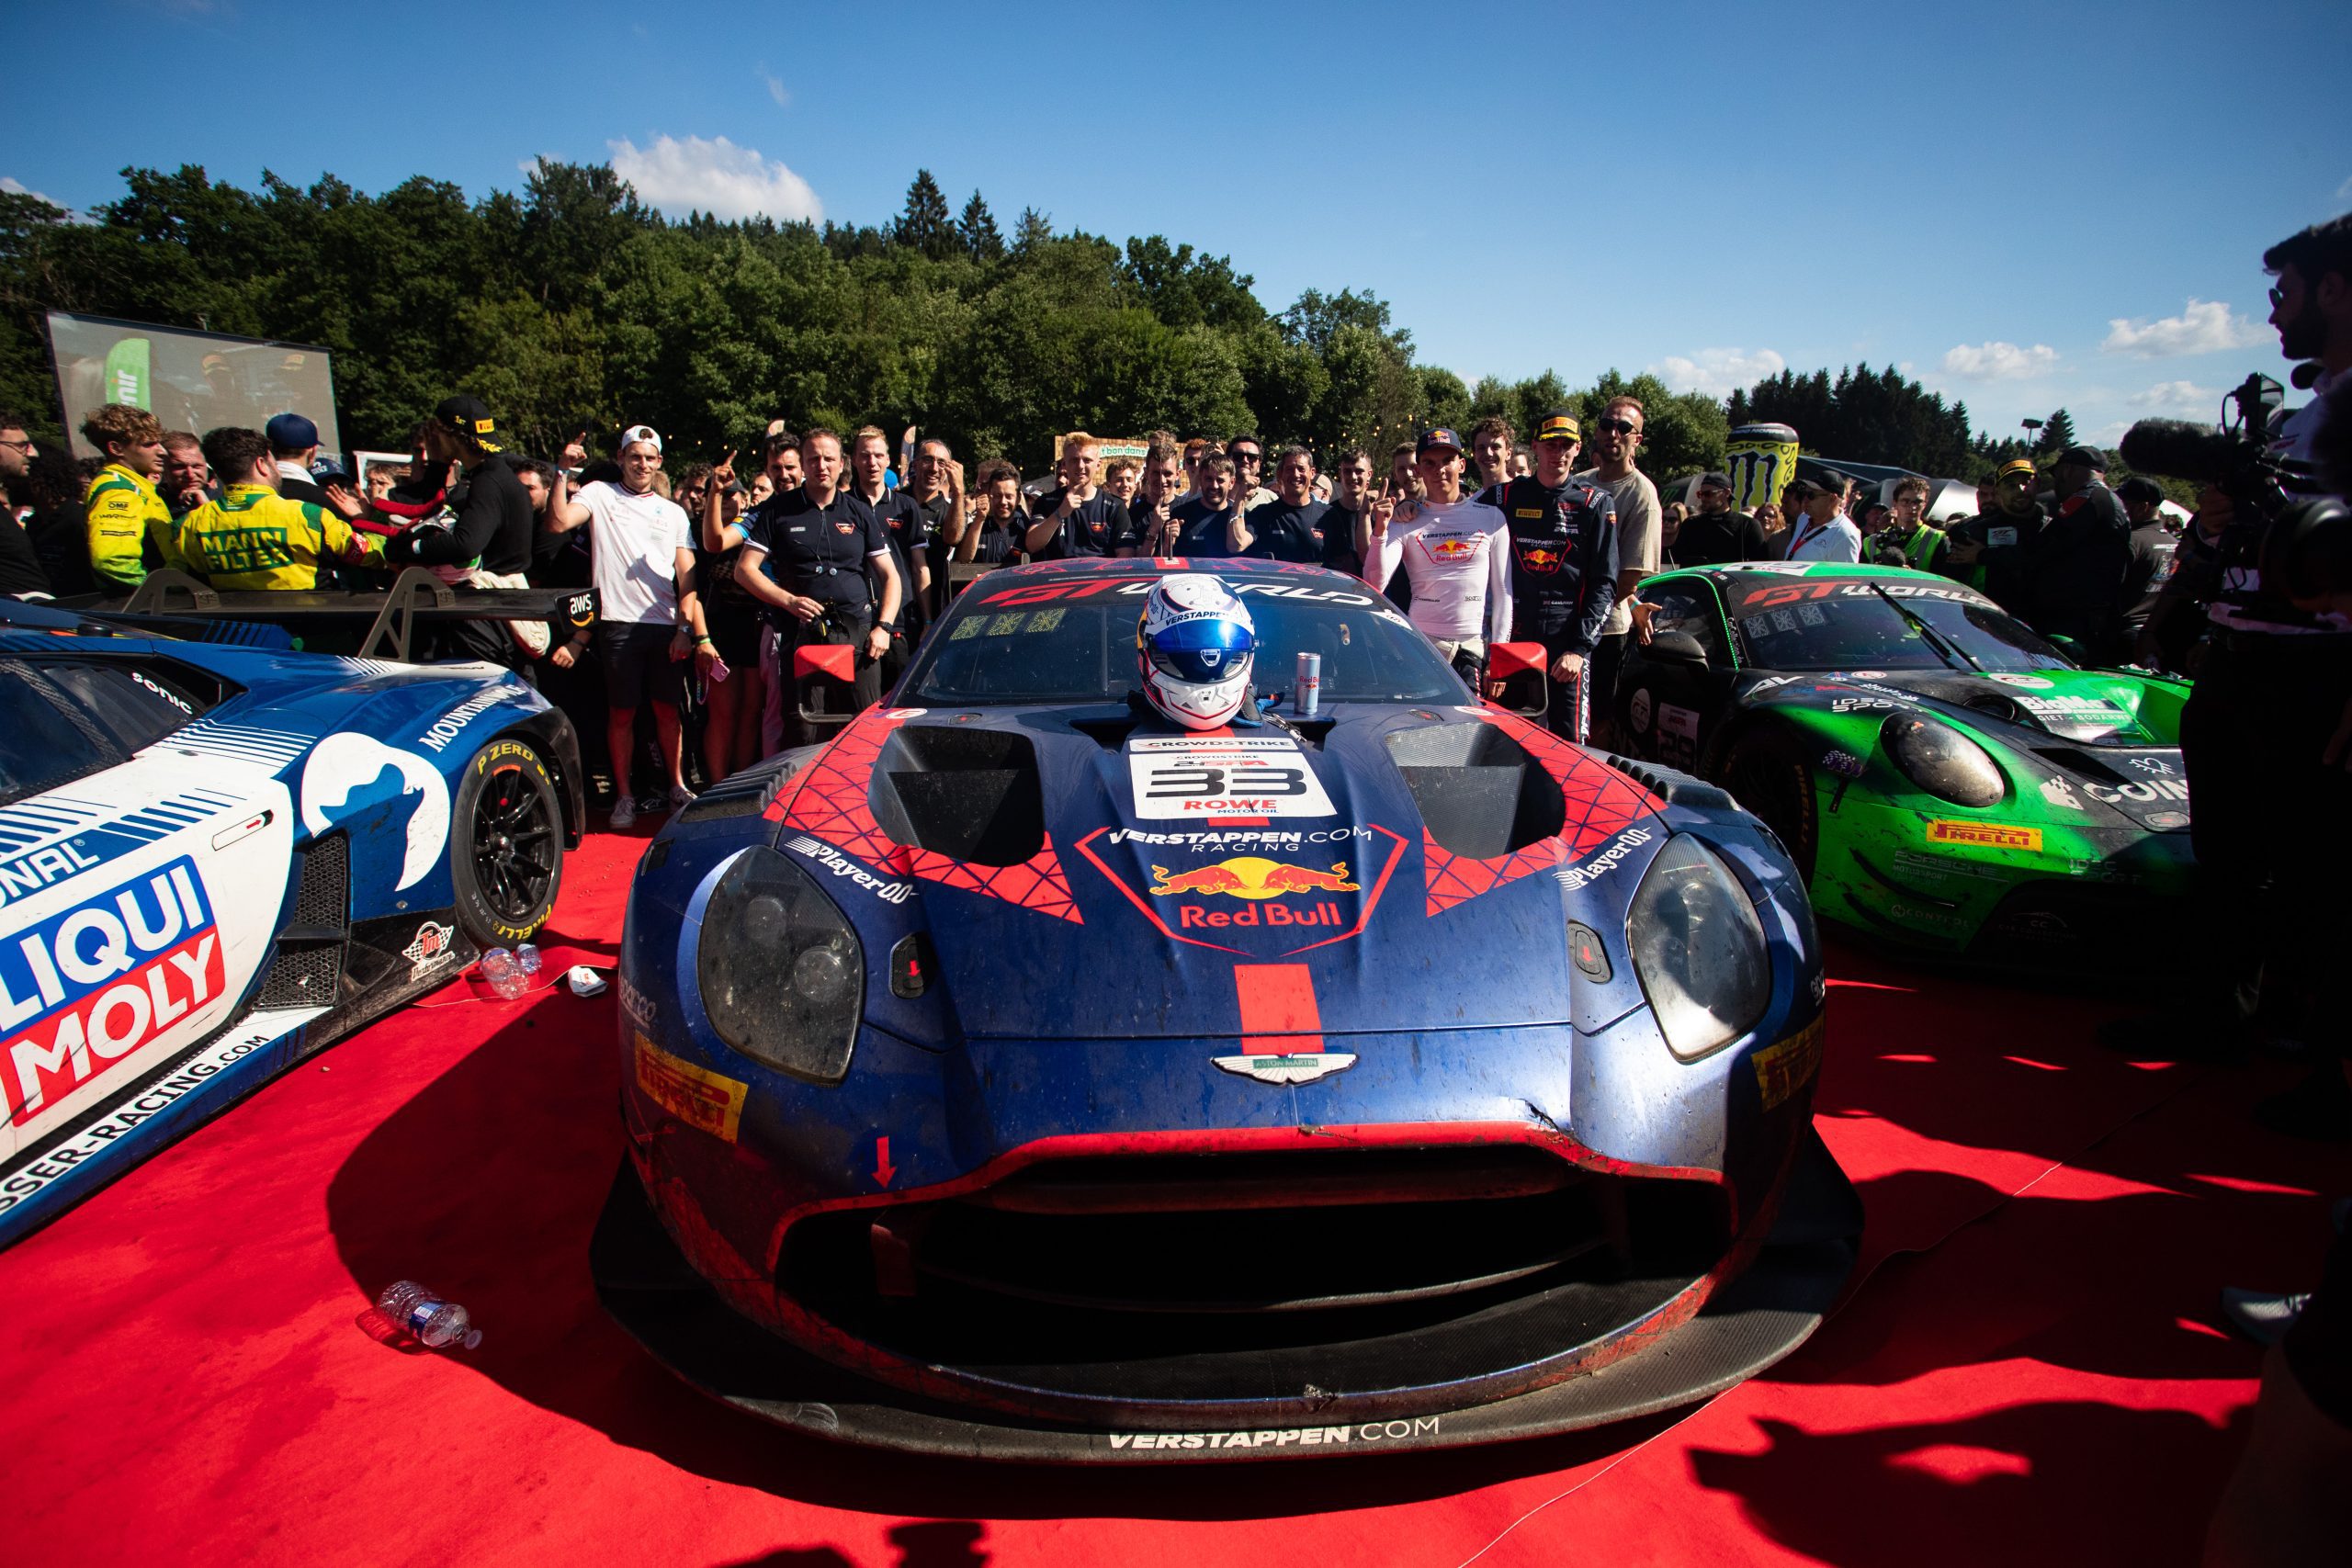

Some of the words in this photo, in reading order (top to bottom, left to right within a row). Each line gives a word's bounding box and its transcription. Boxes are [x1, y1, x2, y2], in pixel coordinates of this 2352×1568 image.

[1106, 446, 1124, 456] bon
[1125, 445, 1146, 456] dans
[201, 530, 283, 552] MANN
[208, 547, 291, 570] FILTER
[570, 594, 593, 615] aws
[478, 755, 487, 775] P
[490, 743, 534, 761] ZERO
[1146, 768, 1307, 798] 33
[1183, 799, 1277, 810] ROWE
[1108, 825, 1373, 845] VERSTAPPEN.COM
[1937, 823, 2030, 846] PIRELLI
[1191, 843, 1299, 852] RACING
[808, 844, 885, 890] Player
[1566, 841, 1633, 887] Player
[1180, 903, 1260, 929] Red
[1263, 902, 1343, 927] Bull
[0, 864, 205, 1032] LIQUI
[9, 932, 216, 1114] MOLY
[1255, 1059, 1284, 1067] ASTON
[1285, 1059, 1317, 1067] MARTIN
